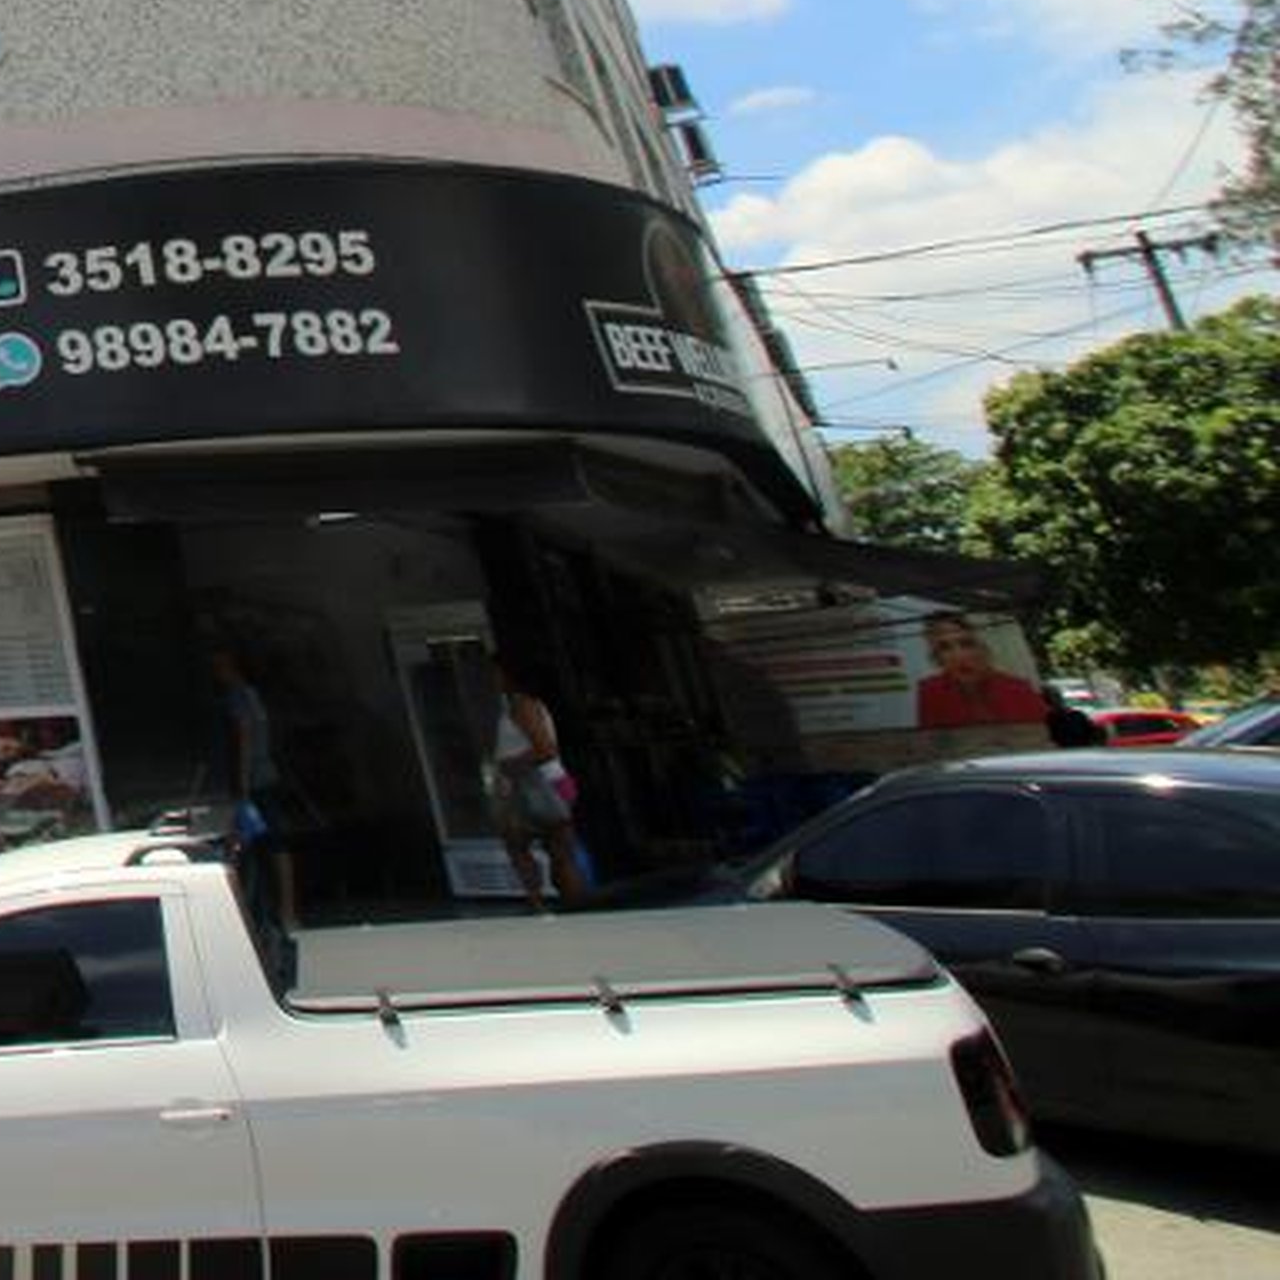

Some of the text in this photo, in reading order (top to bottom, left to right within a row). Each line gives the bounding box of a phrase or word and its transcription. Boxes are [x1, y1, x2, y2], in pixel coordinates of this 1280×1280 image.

[44, 230, 376, 295] 3518-8295
[56, 309, 400, 374] 98984-7882
[603, 322, 673, 372] BEEF
